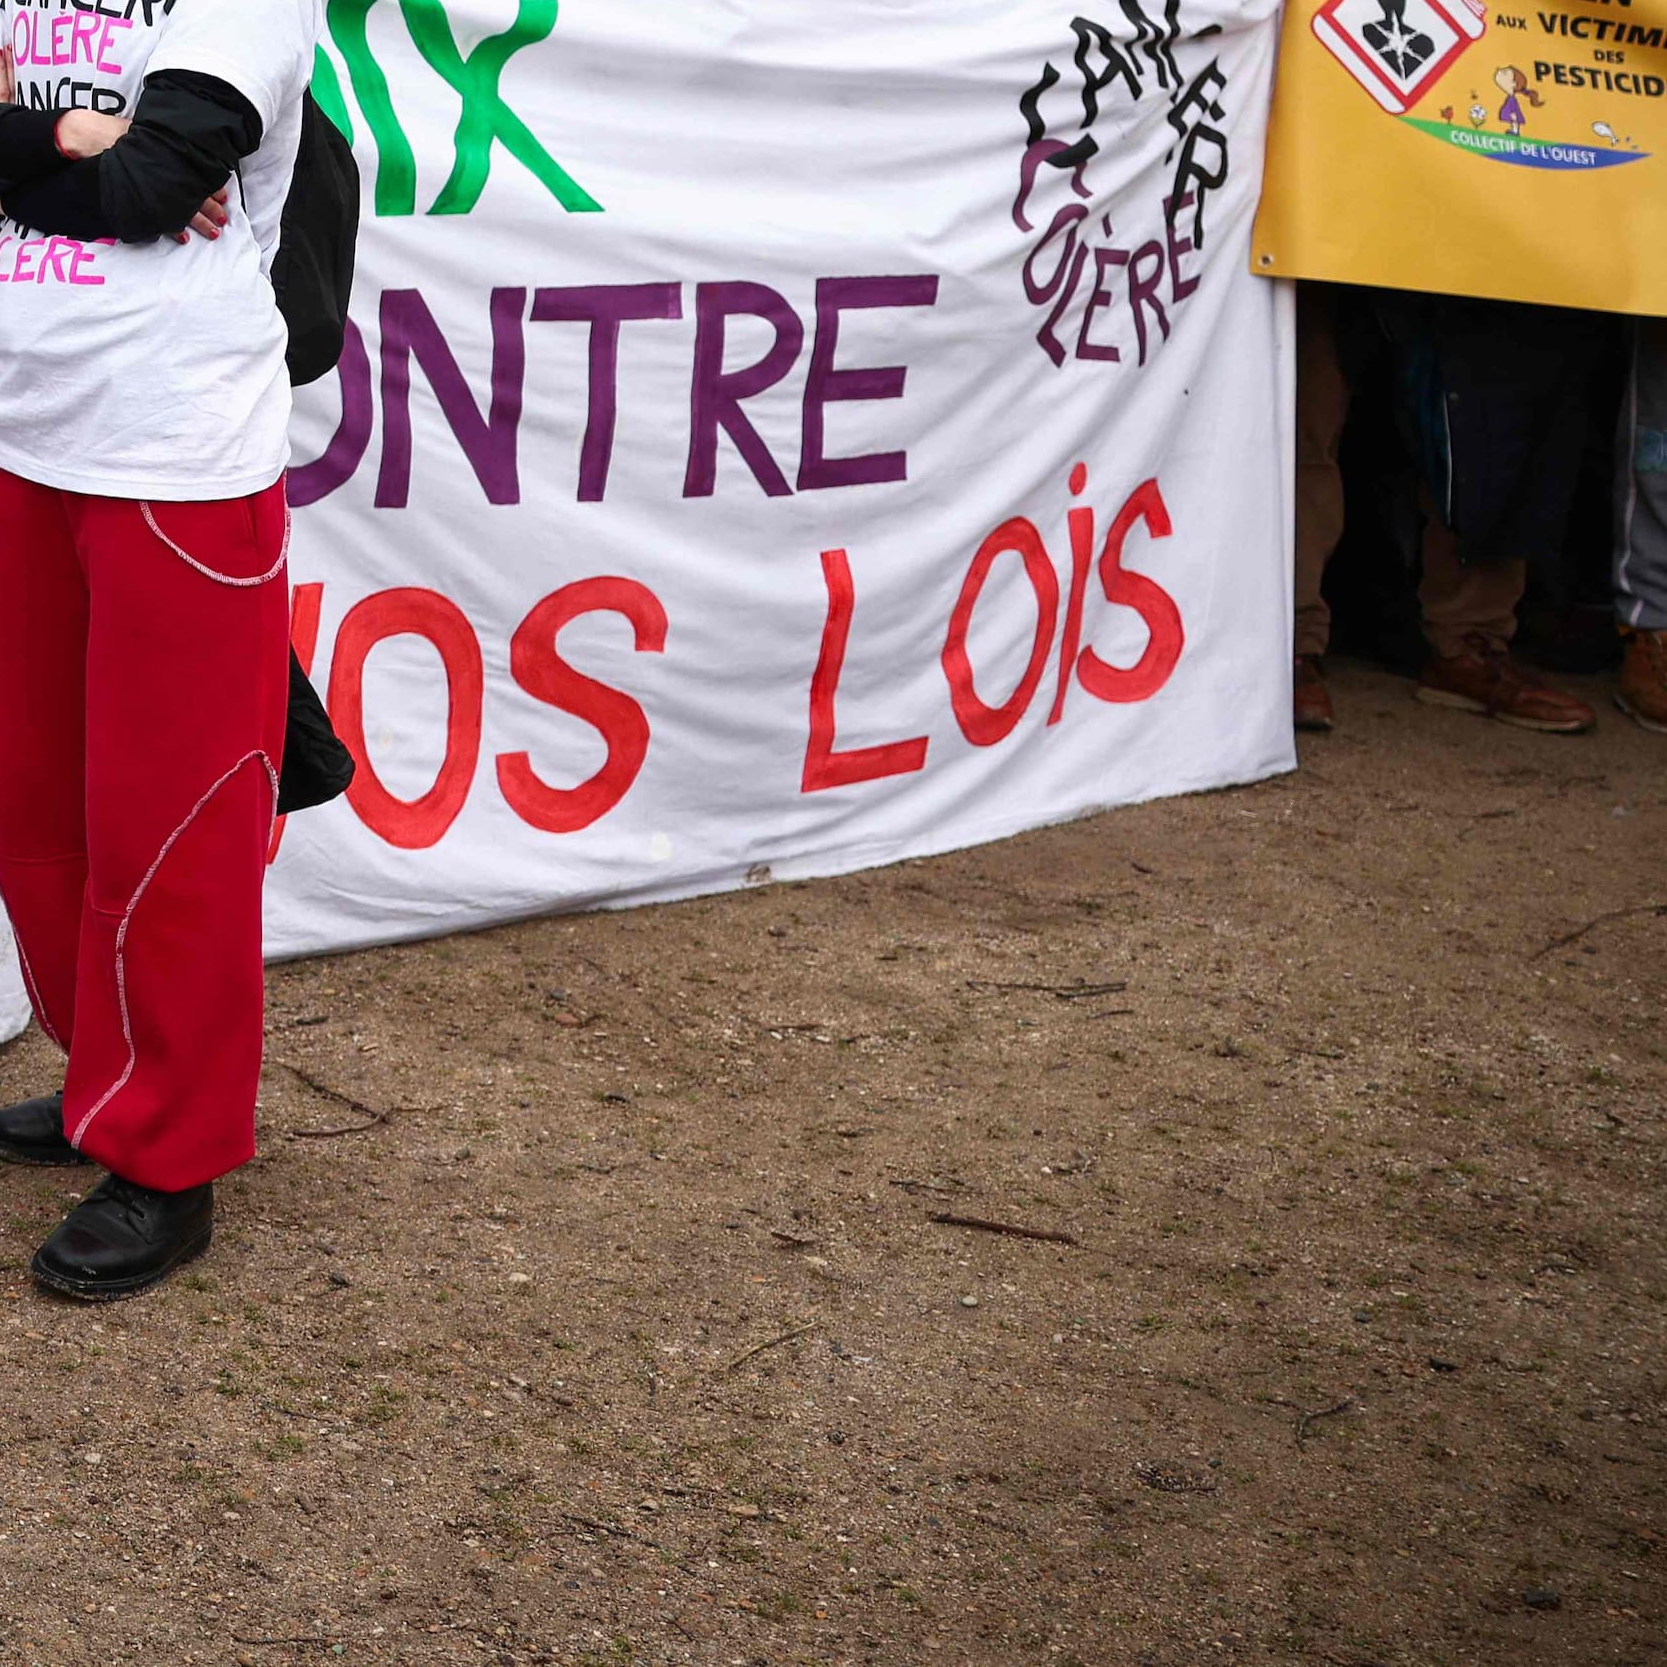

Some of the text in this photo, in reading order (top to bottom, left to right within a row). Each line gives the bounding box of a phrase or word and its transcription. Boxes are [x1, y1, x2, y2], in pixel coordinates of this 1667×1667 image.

[13, 9, 134, 75] OLÈRE
[1496, 12, 1667, 49] AUX VICTIM
[1593, 49, 1625, 64] DES
[1533, 61, 1667, 98] PESTICID
[1451, 129, 1597, 166] COLLECTIF DE L'OUEST
[287, 275, 940, 509] ONTRE
